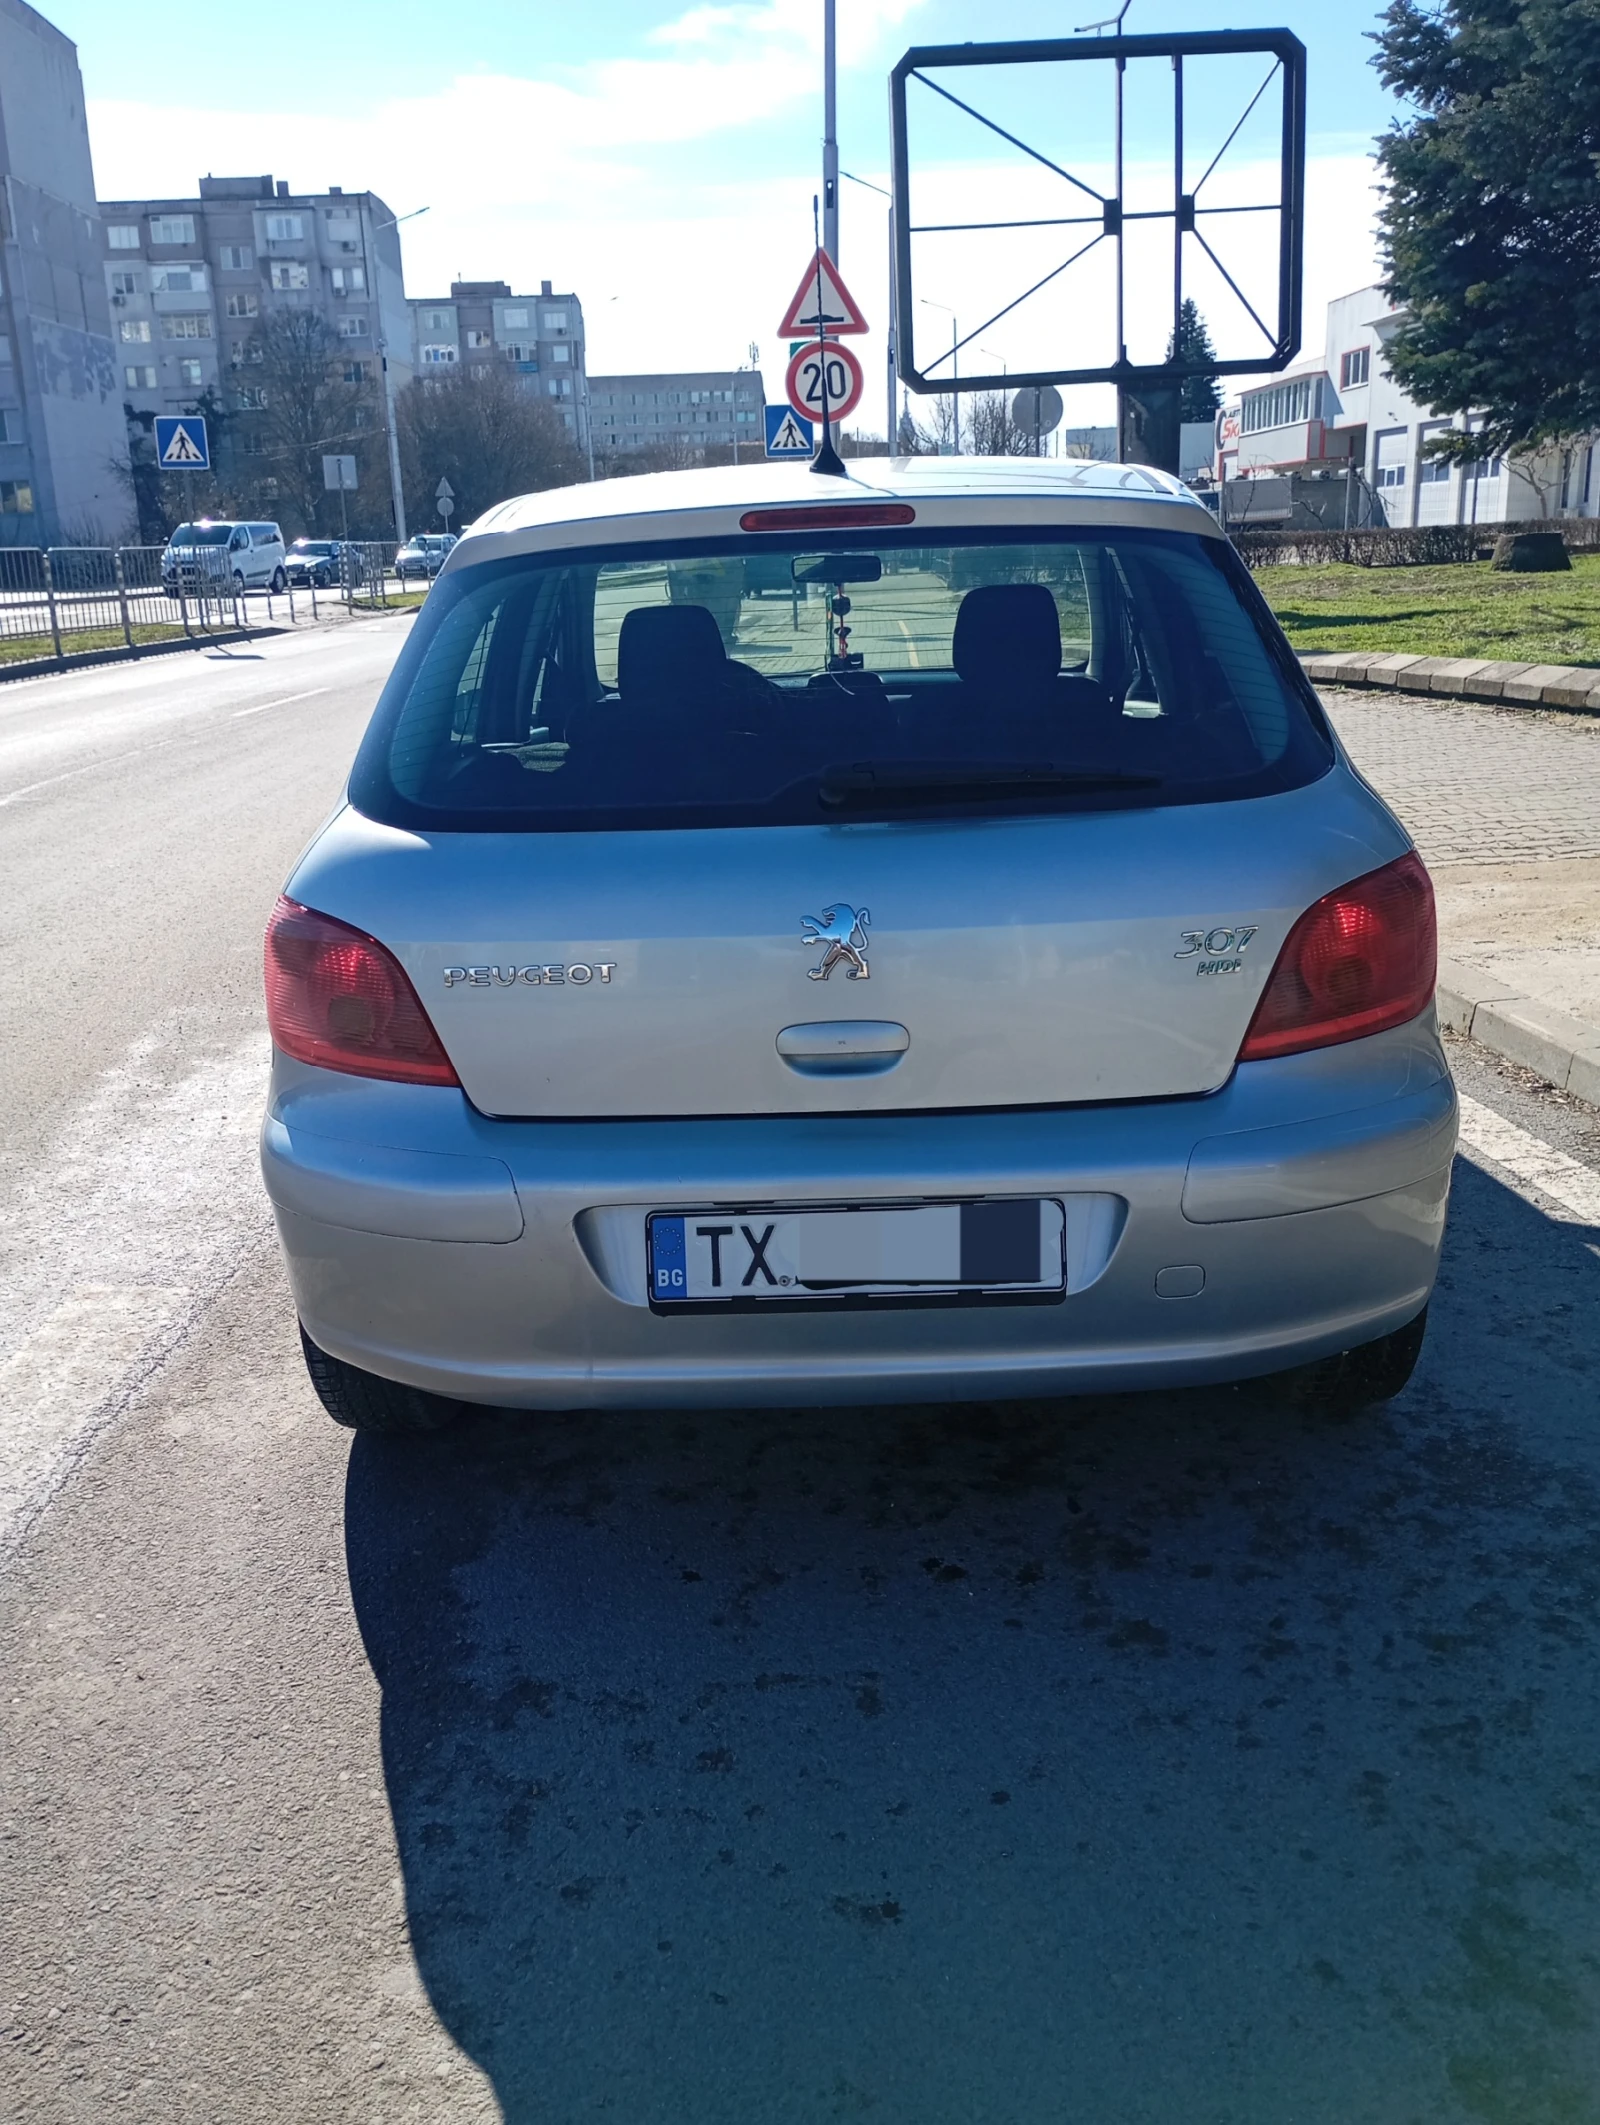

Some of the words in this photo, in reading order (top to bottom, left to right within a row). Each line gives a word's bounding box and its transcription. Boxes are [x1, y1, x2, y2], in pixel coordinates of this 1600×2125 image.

[803, 360, 847, 402] 20
[1174, 925, 1259, 959] 307
[443, 962, 617, 988] PEUGEOT
[696, 1225, 778, 1287] TX
[657, 1268, 684, 1287] BG
